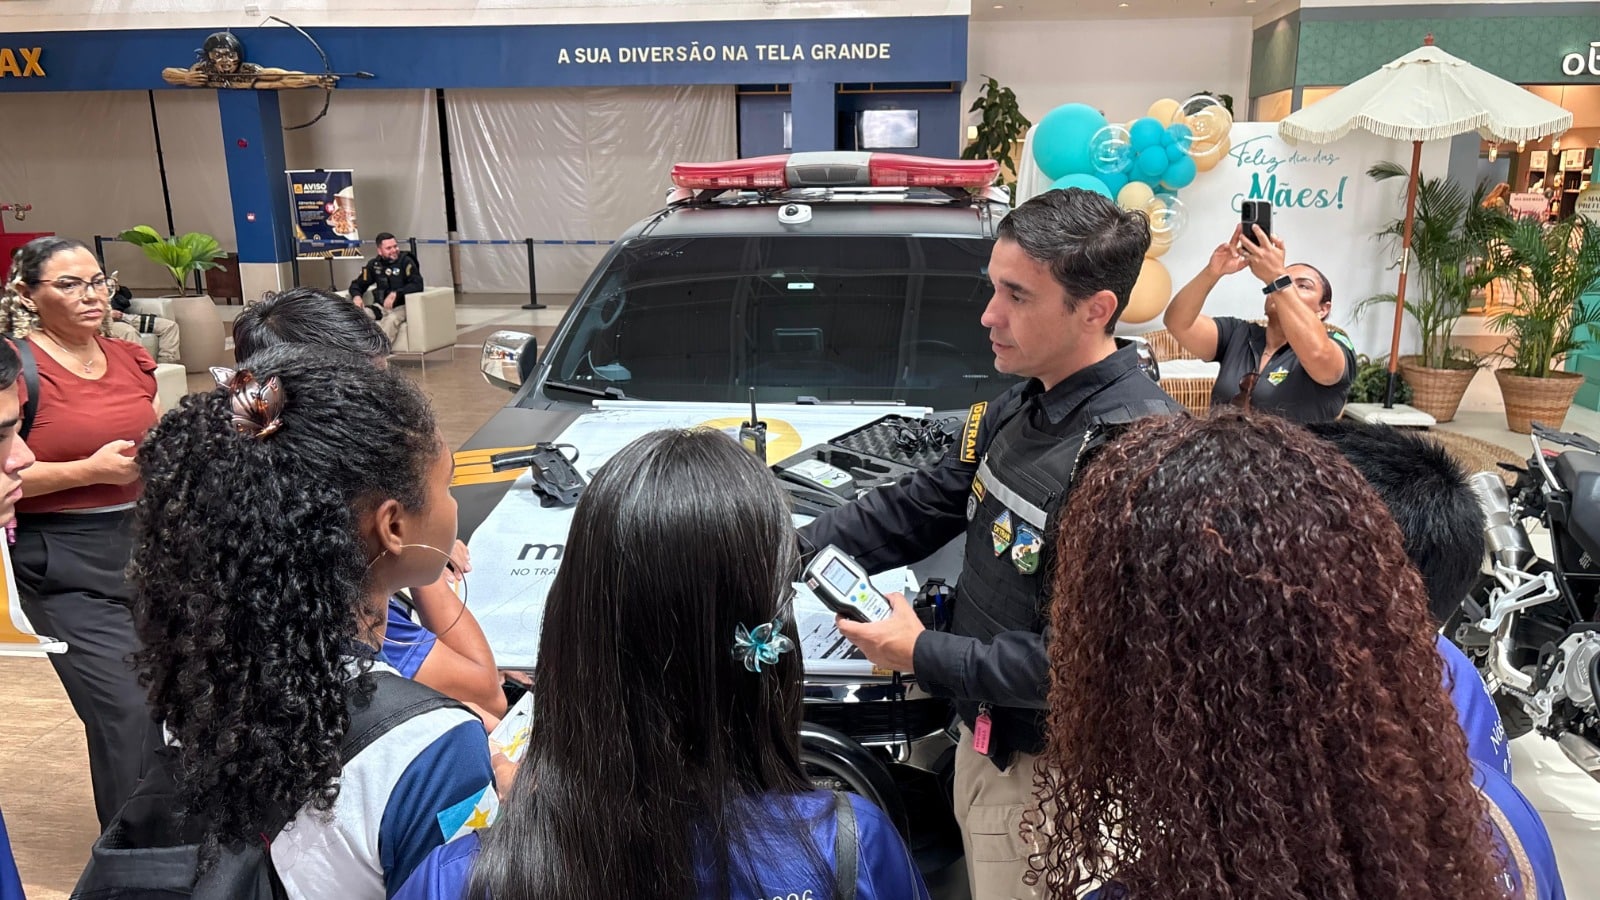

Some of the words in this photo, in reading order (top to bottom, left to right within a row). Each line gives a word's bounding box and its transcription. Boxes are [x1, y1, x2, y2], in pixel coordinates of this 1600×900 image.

[557, 48, 571, 64] A
[574, 47, 612, 63] SUA
[618, 41, 716, 63] DIVERSÃO
[722, 45, 749, 61] NA
[755, 44, 805, 61] TELA
[810, 43, 891, 60] GRANDE
[1228, 135, 1287, 173] Feliz
[1232, 172, 1348, 211] Mães!
[966, 403, 983, 460] DETRAN
[510, 568, 530, 576] NO
